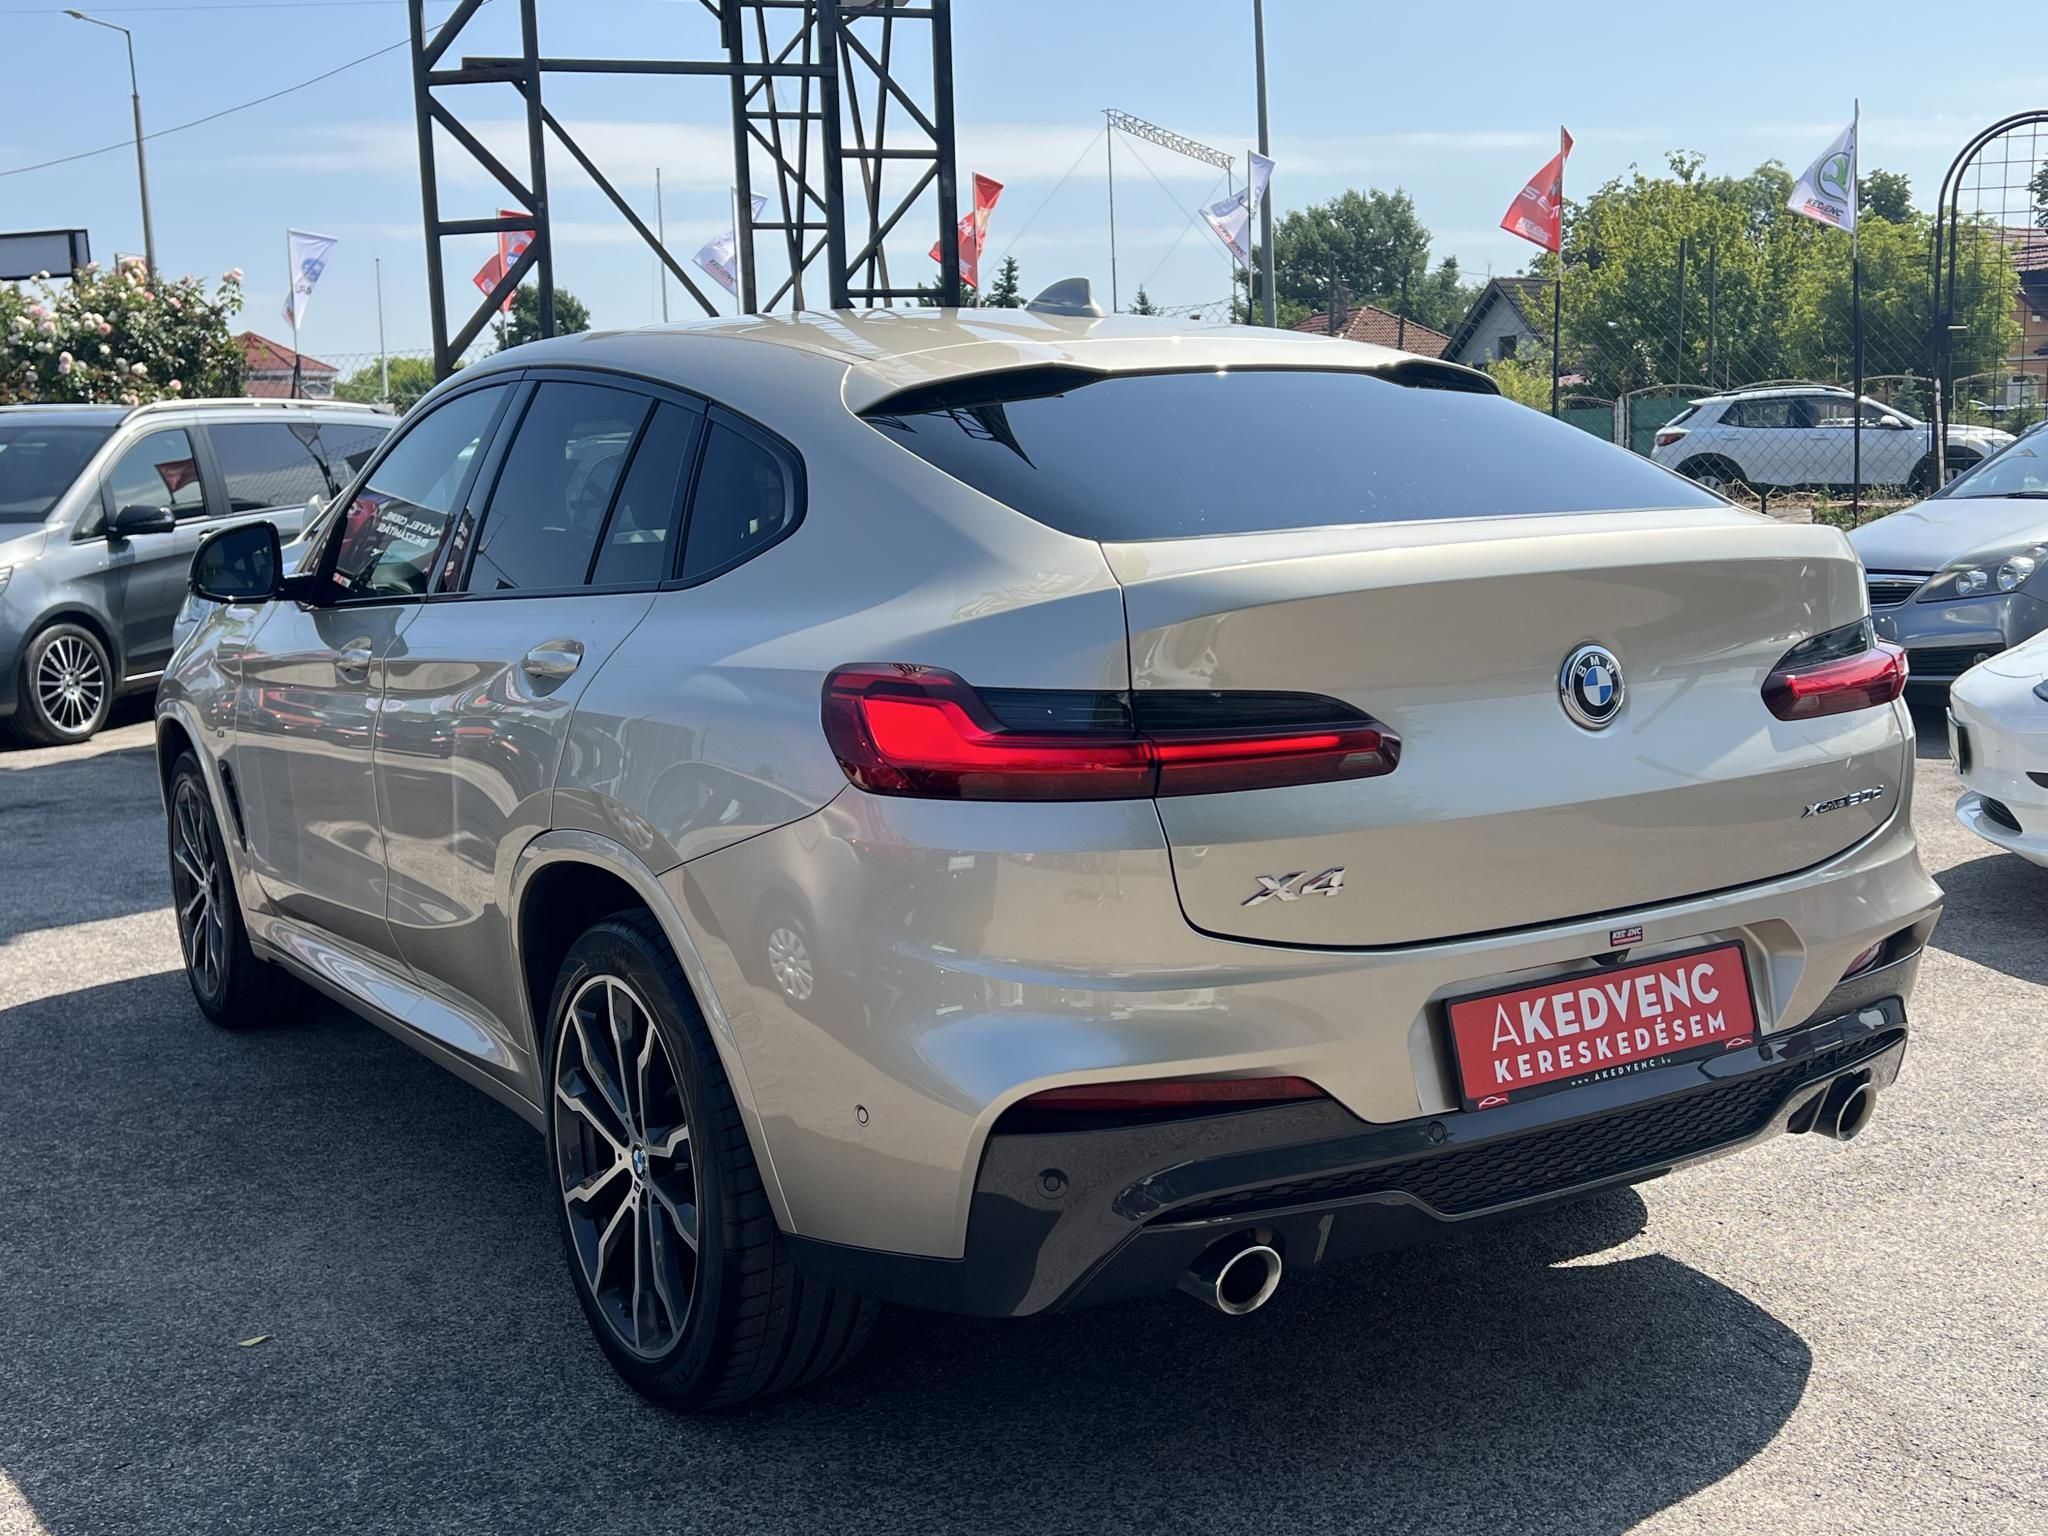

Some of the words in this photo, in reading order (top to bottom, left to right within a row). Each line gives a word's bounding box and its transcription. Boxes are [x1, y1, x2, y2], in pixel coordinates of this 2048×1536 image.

[1576, 655, 1616, 678] BMW
[1240, 866, 1345, 907] X4
[1612, 927, 1642, 940] KEDENC
[1493, 1009, 1727, 1084] KERESKEDÉSEM
